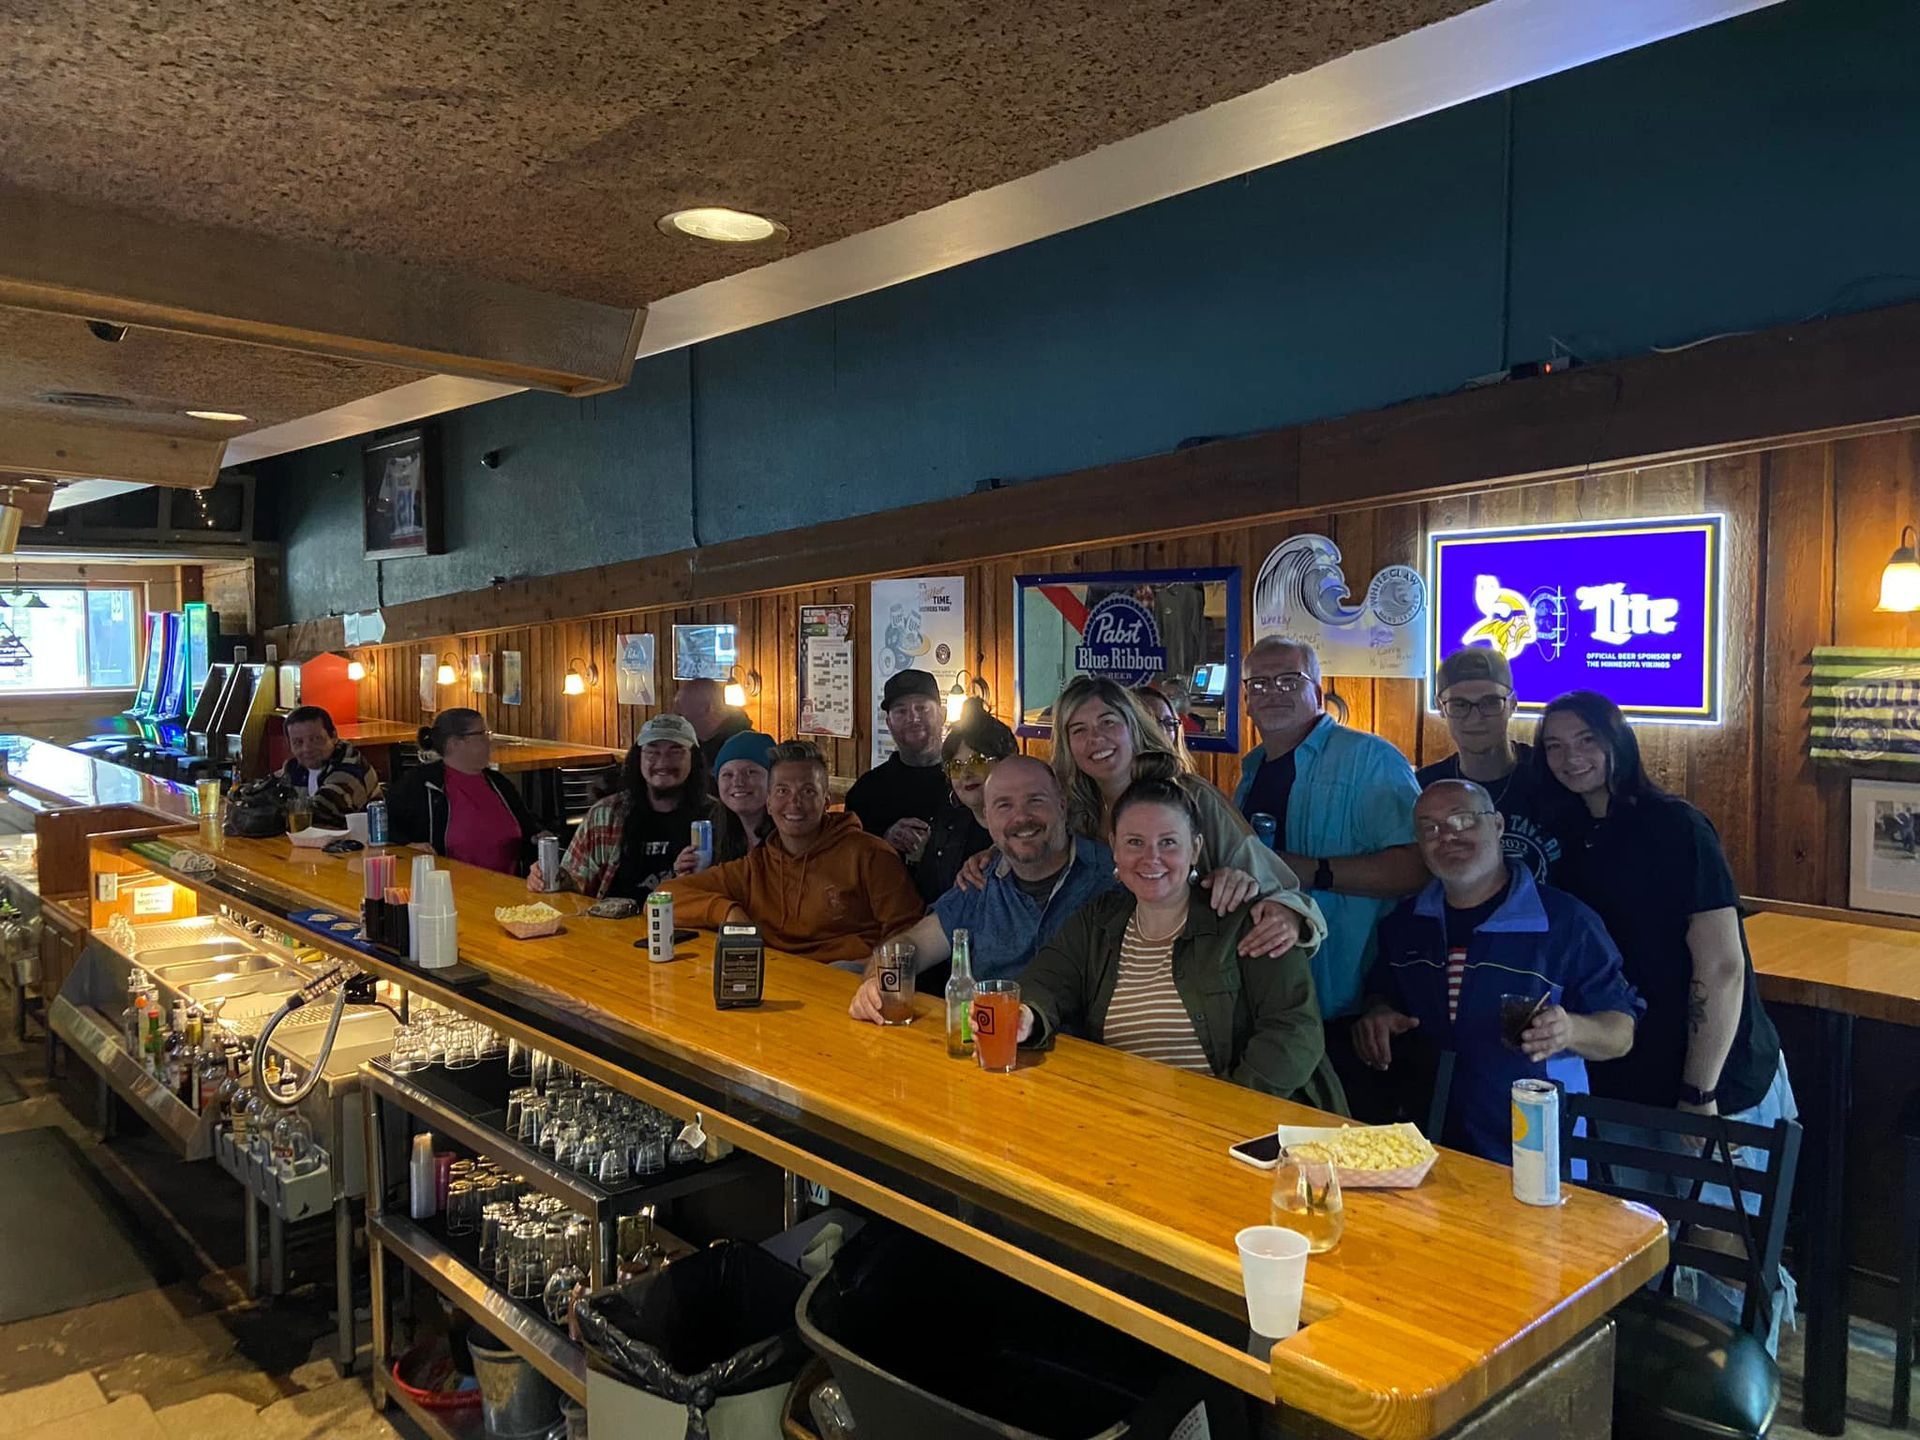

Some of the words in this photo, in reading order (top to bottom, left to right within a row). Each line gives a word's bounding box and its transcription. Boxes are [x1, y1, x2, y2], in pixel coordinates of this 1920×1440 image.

[1390, 569, 1419, 585] CLAW
[1576, 583, 1679, 645] Lite
[1096, 612, 1142, 644] Pabst
[1079, 647, 1110, 669] Blue
[1112, 648, 1163, 671] Ribbon
[1586, 652, 1616, 660] OFFICIAL
[1617, 652, 1636, 660] BEER
[1641, 661, 1671, 669] VIKINGS
